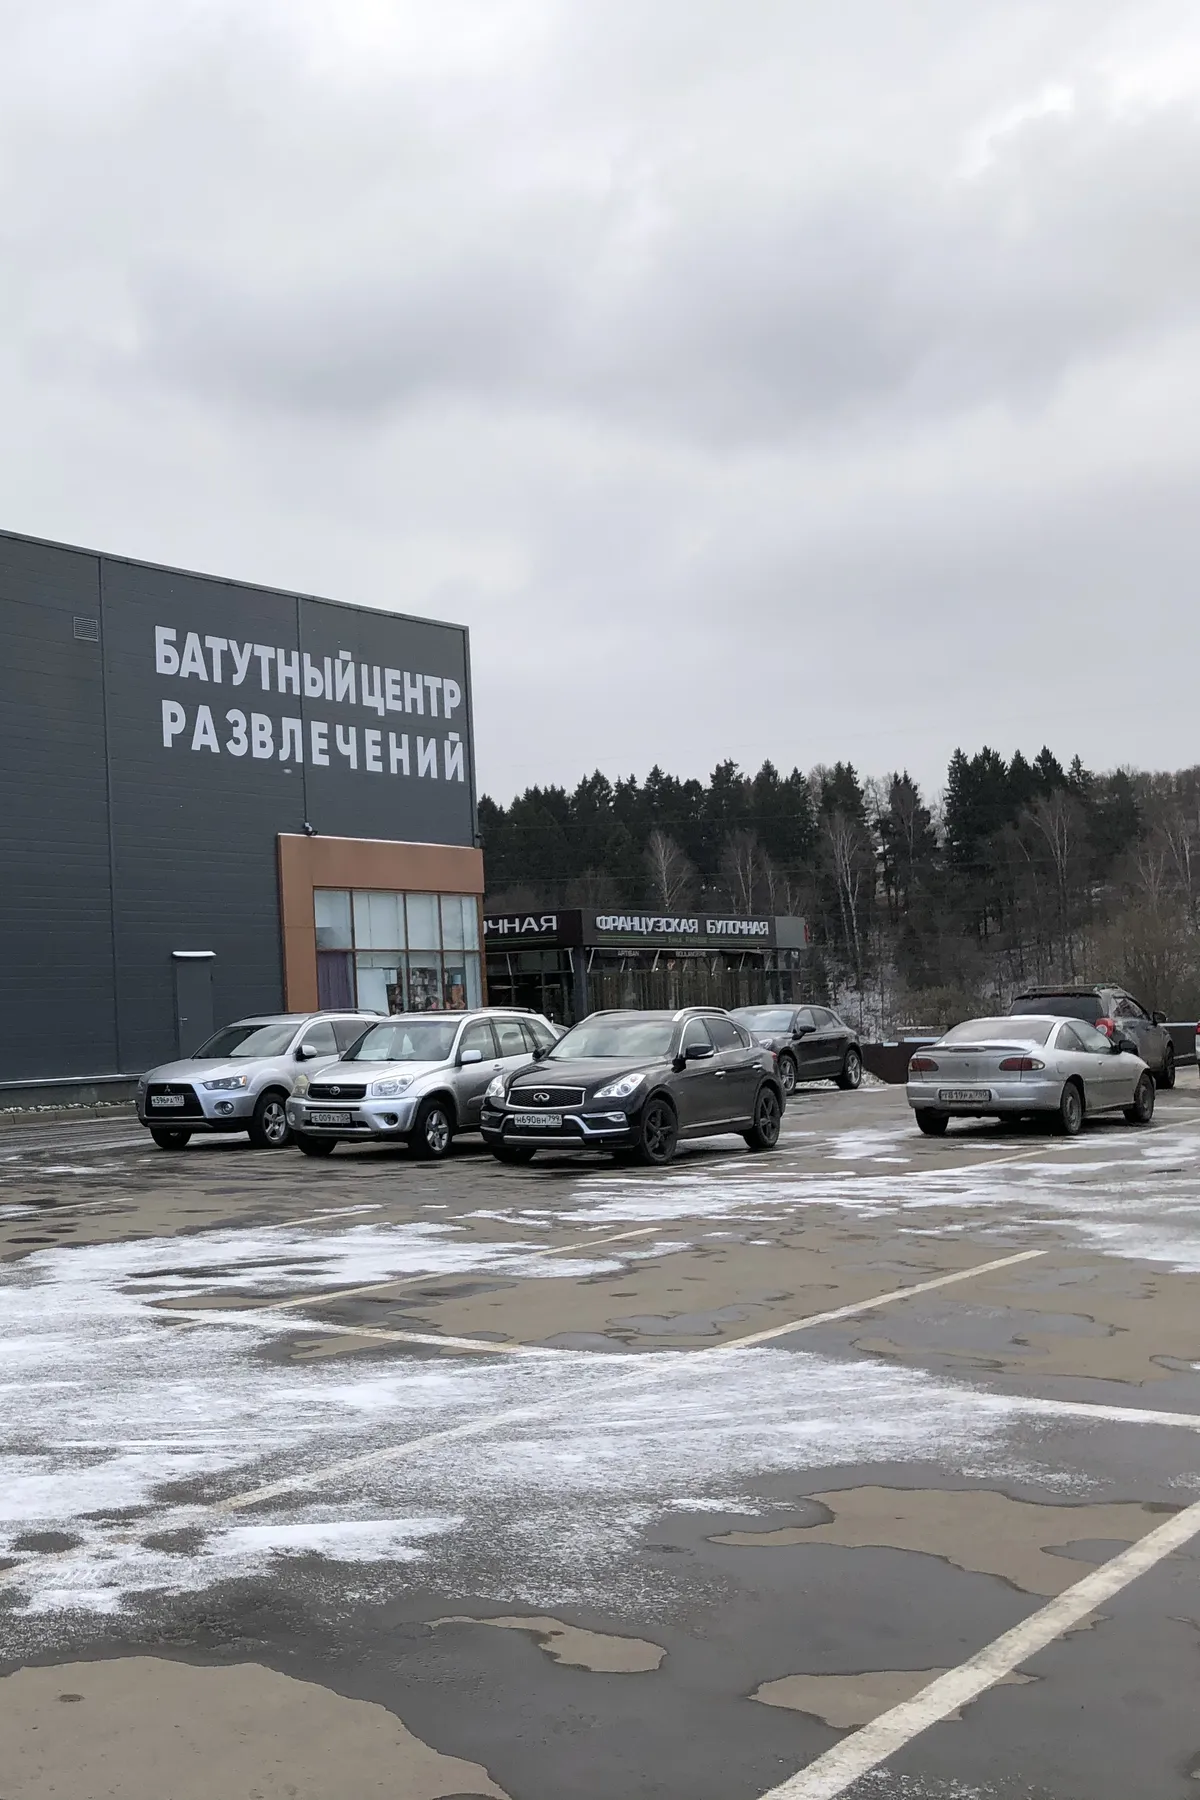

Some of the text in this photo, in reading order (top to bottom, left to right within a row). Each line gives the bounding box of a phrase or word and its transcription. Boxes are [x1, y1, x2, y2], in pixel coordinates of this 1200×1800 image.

[161, 700, 464, 782] РАЗВЛЕЧЕНИЙ
[596, 915, 769, 935] ФРАНЦУЗСКАЯ БУЛОЧНАЯ
